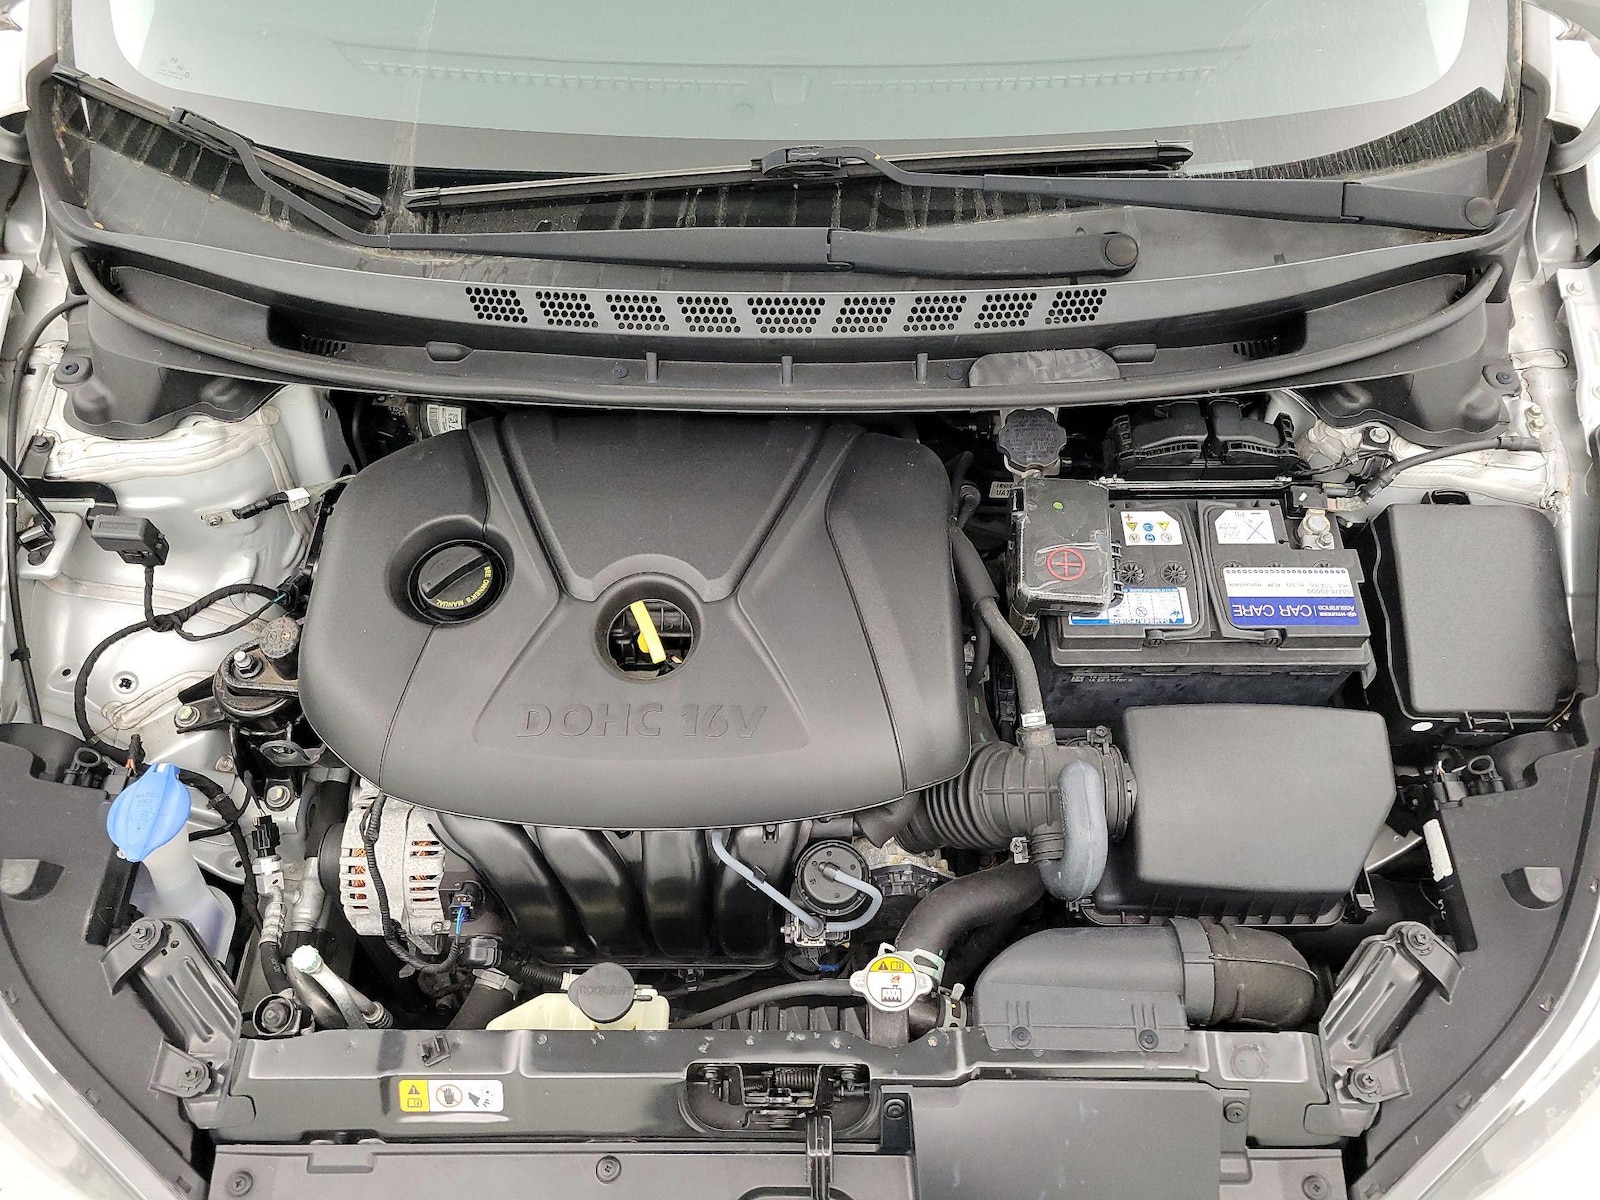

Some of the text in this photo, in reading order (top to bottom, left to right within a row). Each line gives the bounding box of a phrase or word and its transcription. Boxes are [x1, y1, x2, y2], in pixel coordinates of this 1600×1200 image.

[436, 565, 491, 608] SEE OWNER'S MANUAL
[1233, 604, 1312, 617] CAR CARE
[515, 702, 769, 739] DOHC 16V
